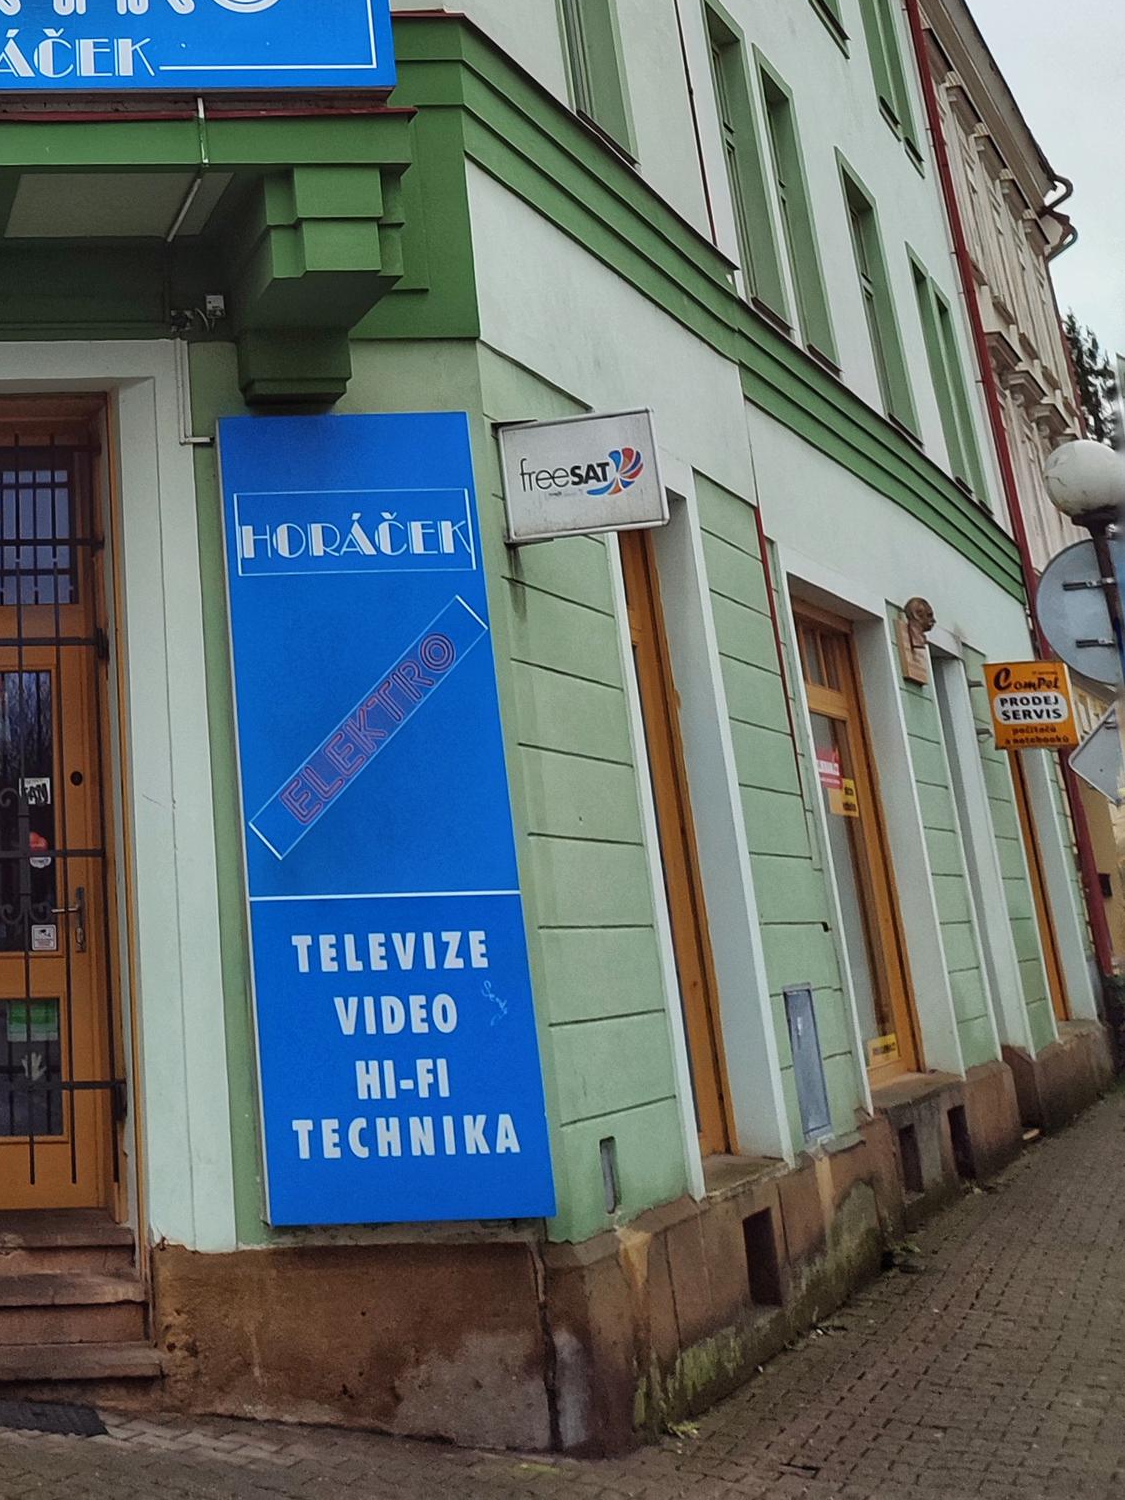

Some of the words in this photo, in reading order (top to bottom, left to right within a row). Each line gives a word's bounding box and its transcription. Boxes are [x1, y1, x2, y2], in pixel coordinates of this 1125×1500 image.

[519, 457, 610, 492] freeSAT
[238, 511, 472, 559] HORÁČEK
[999, 695, 1059, 708] PRODEJ
[1001, 708, 1062, 721] SERVIS
[279, 632, 455, 825] ELEKTRO
[291, 930, 489, 973] TELEVIZE
[333, 993, 458, 1035] VIDEO
[354, 1058, 451, 1100] HI-FI
[291, 1113, 521, 1160] TECHNIKA
